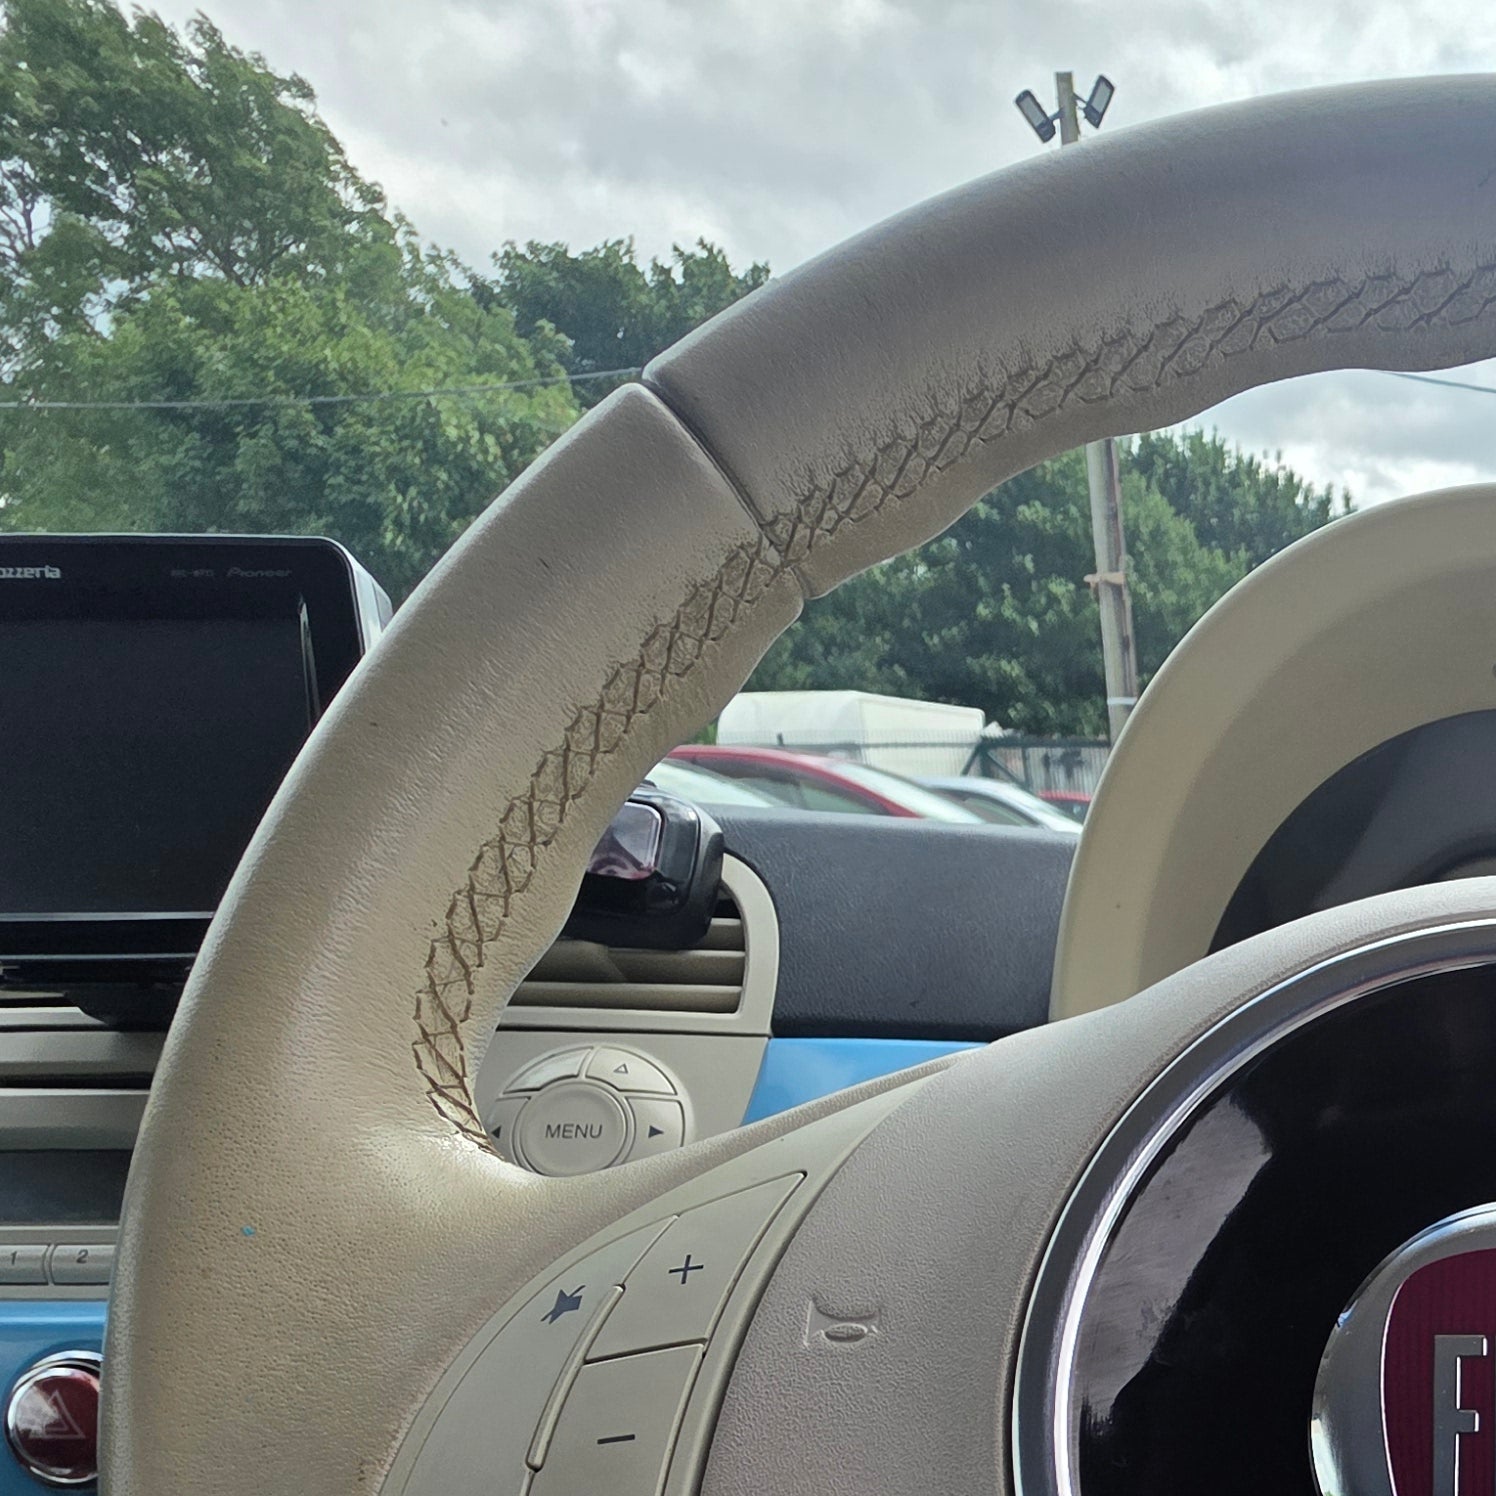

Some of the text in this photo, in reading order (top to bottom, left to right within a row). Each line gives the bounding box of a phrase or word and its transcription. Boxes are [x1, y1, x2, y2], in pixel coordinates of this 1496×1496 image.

[545, 1123, 603, 1139] MENU
[11, 1250, 18, 1266] 1
[76, 1249, 89, 1264] 2
